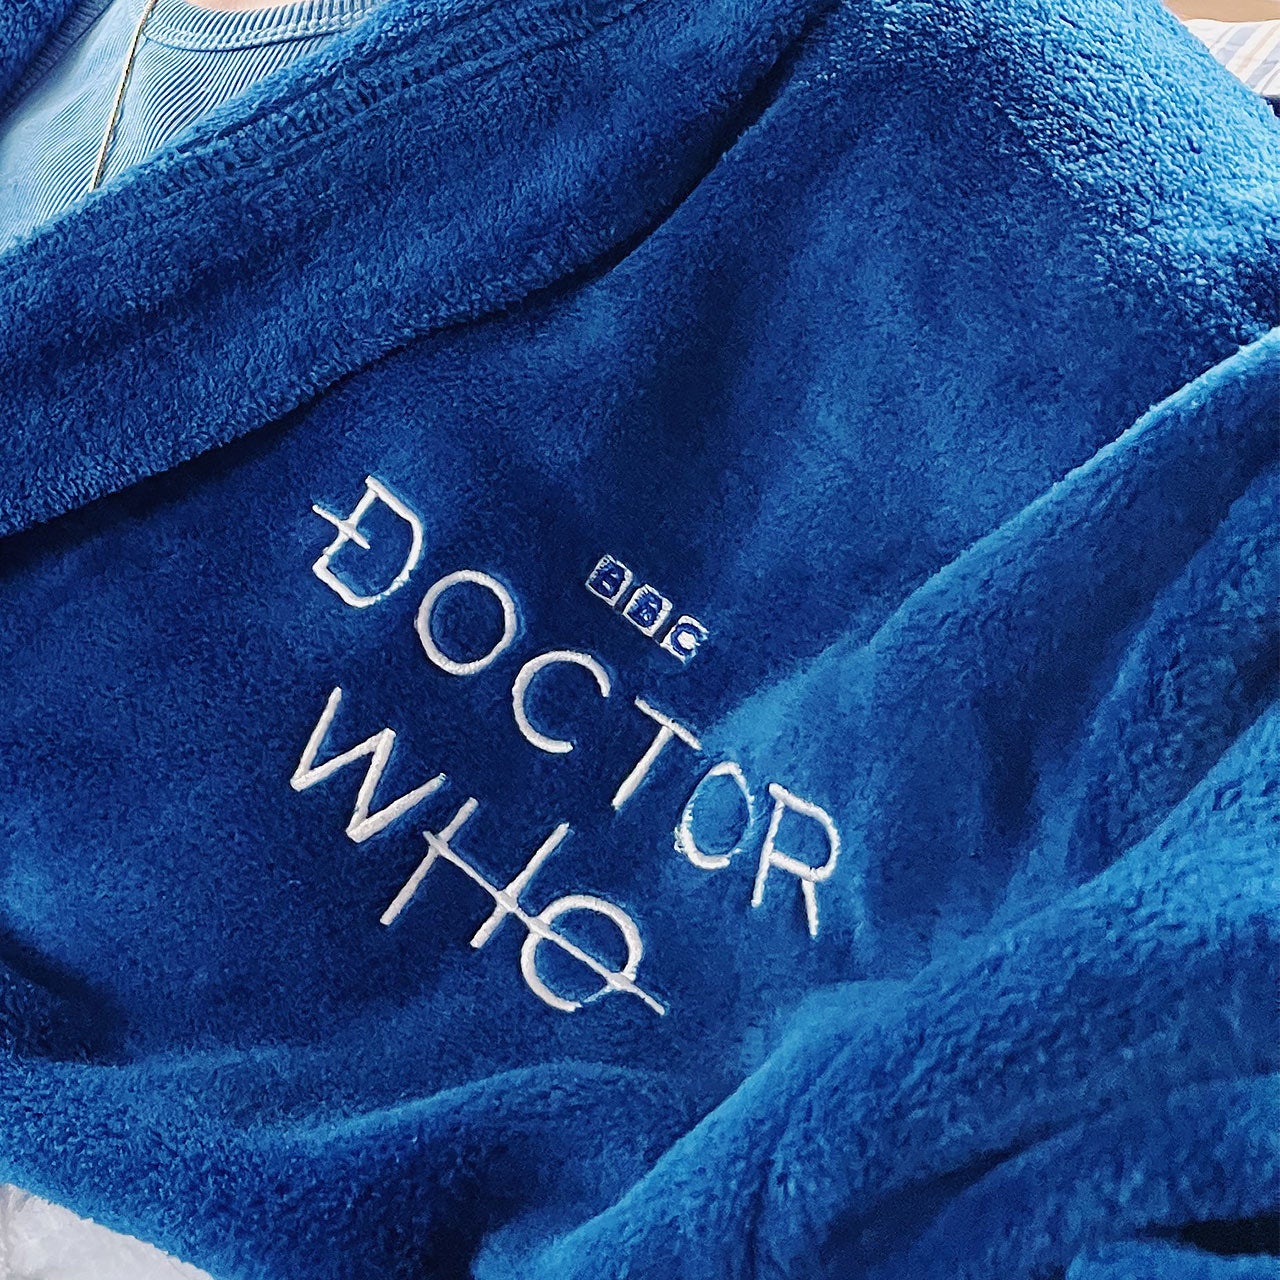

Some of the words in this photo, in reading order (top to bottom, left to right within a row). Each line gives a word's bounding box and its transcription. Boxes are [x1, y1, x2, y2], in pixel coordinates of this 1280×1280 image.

[311, 475, 841, 937] DOCTOR
[585, 553, 709, 664] BBC
[289, 686, 666, 1015] WHO
